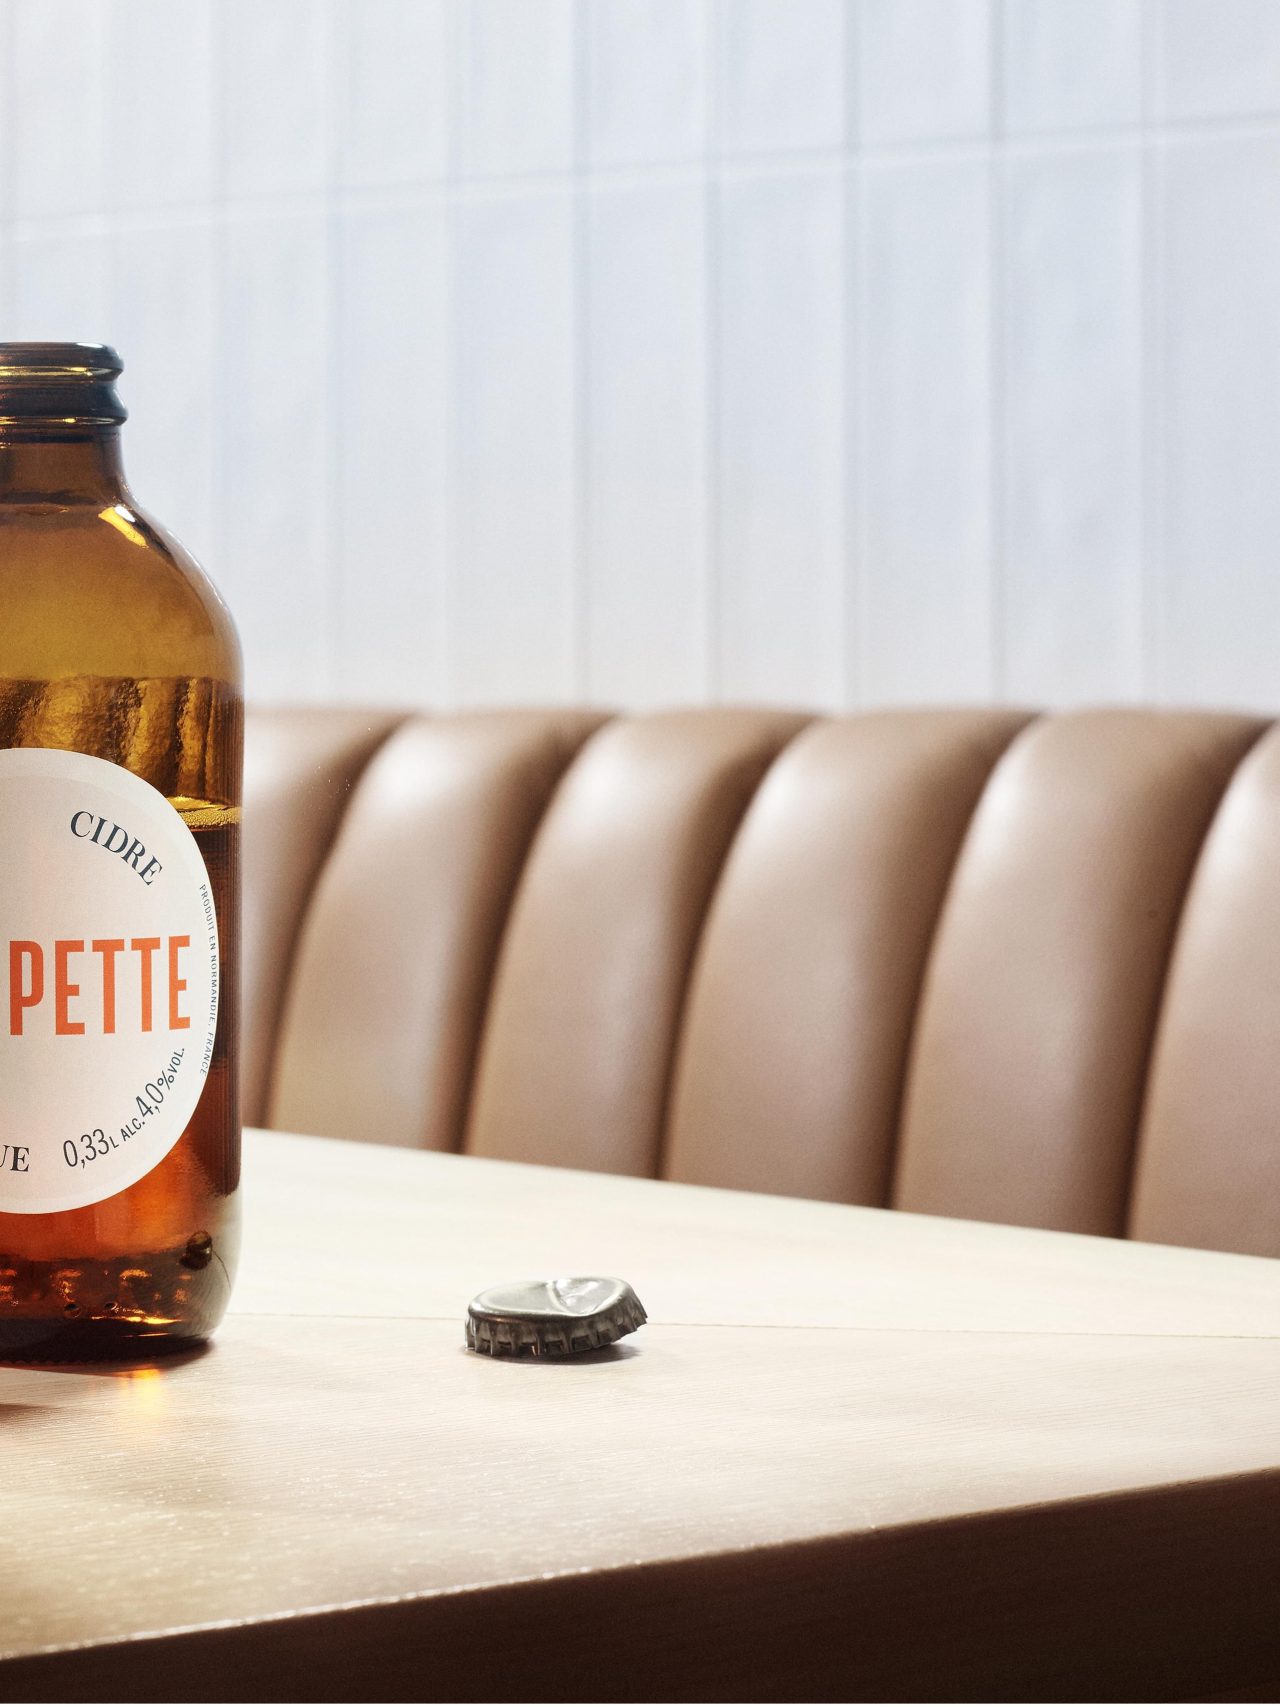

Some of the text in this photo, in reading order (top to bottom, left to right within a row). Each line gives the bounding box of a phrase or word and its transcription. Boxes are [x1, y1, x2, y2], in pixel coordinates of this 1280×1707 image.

[70, 811, 163, 885] CIDRE
[199, 884, 215, 930] PRODUIT
[200, 1032, 214, 1075] FRANCE
